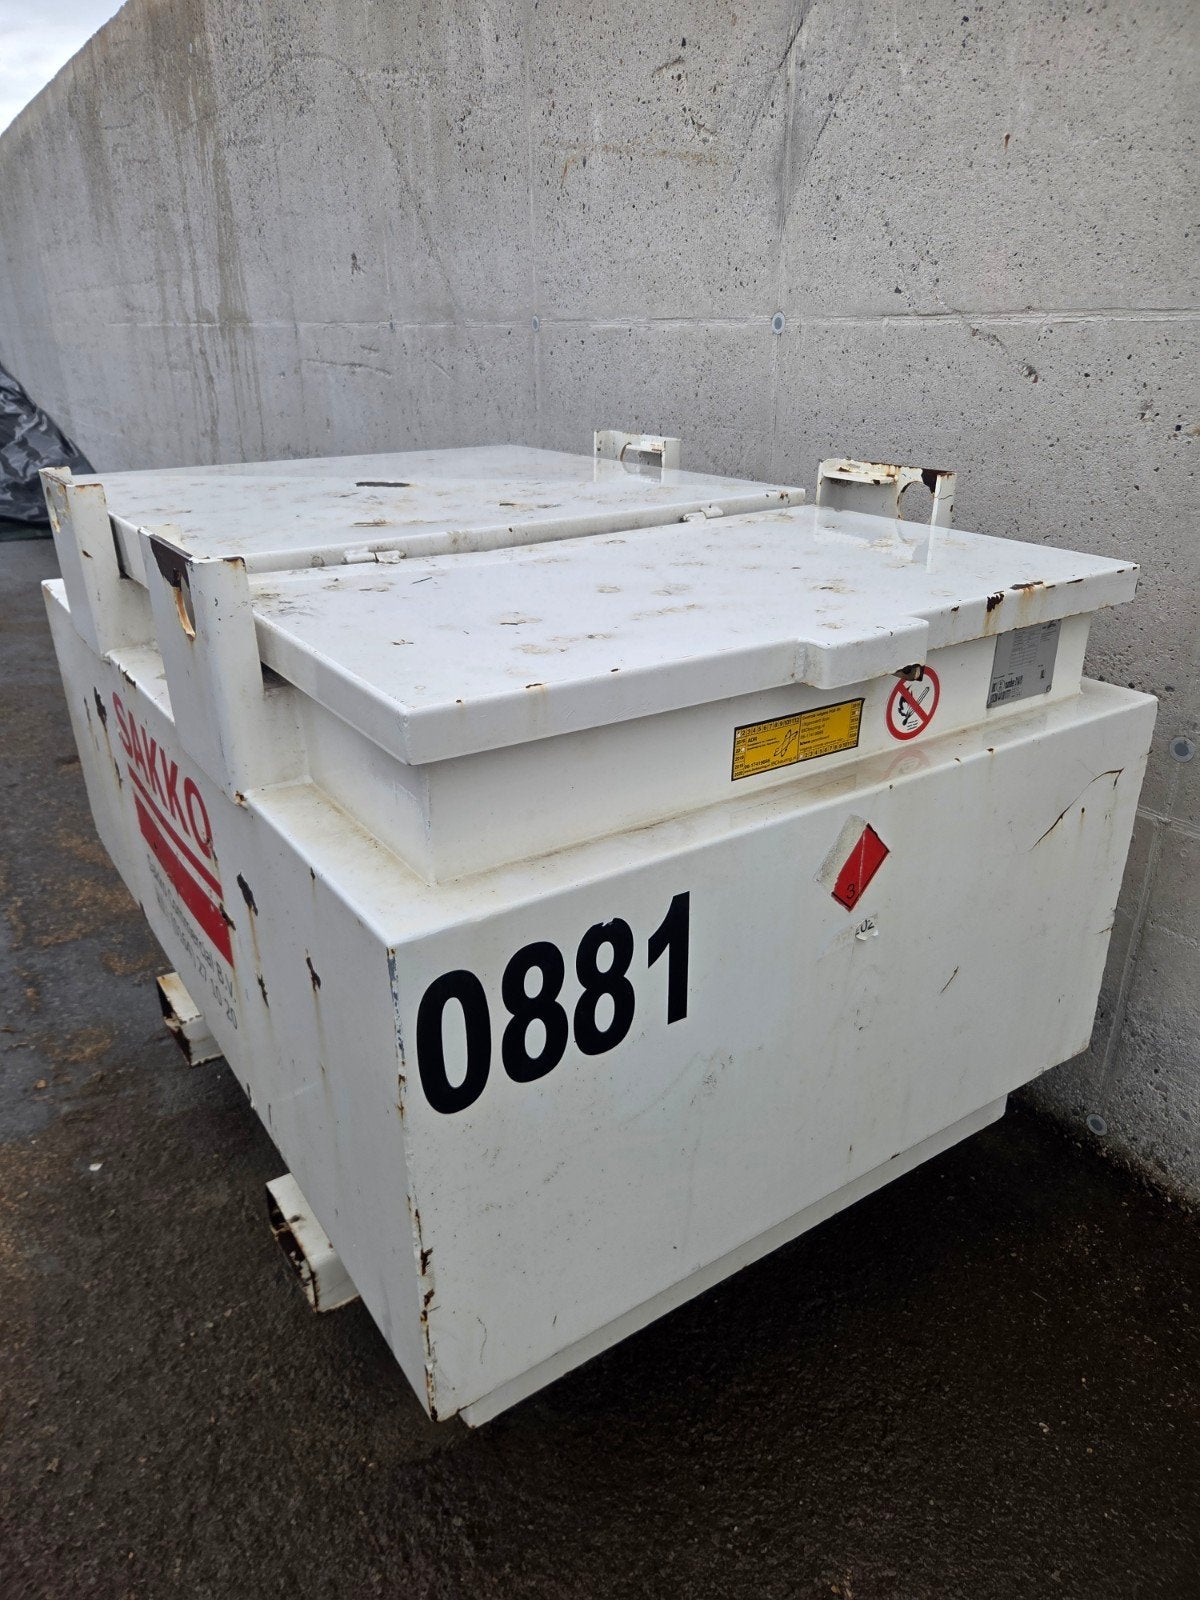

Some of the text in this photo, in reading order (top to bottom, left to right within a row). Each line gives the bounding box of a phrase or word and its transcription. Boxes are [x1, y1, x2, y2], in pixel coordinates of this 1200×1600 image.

[112, 691, 213, 860] SAKKO
[846, 883, 856, 899] 3
[224, 998, 237, 1030] 20
[416, 890, 690, 1115] 0881
